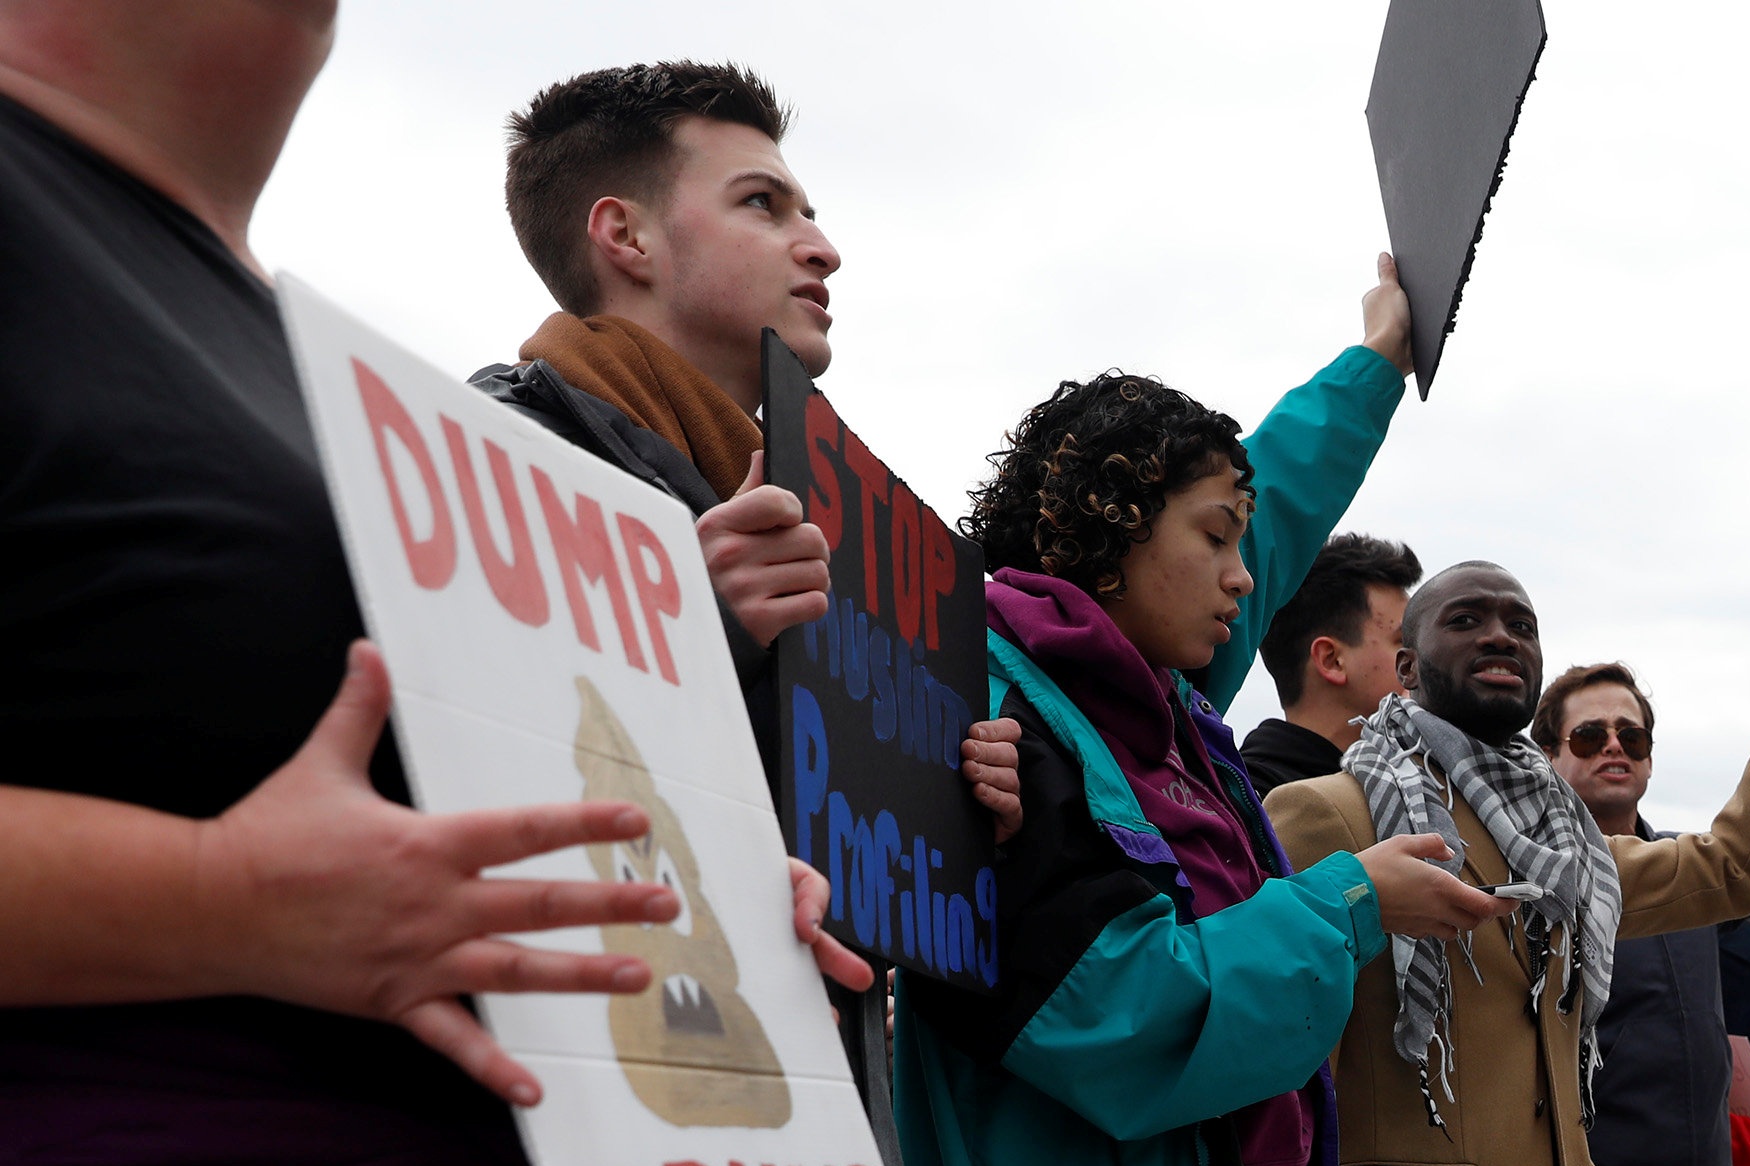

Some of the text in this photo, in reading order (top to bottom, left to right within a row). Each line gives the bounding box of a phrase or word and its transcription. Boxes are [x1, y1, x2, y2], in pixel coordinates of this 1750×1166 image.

[349, 356, 681, 687] DUMP
[805, 394, 956, 651] STOP
[803, 587, 974, 771] Muslim
[793, 683, 998, 988] Profiling
